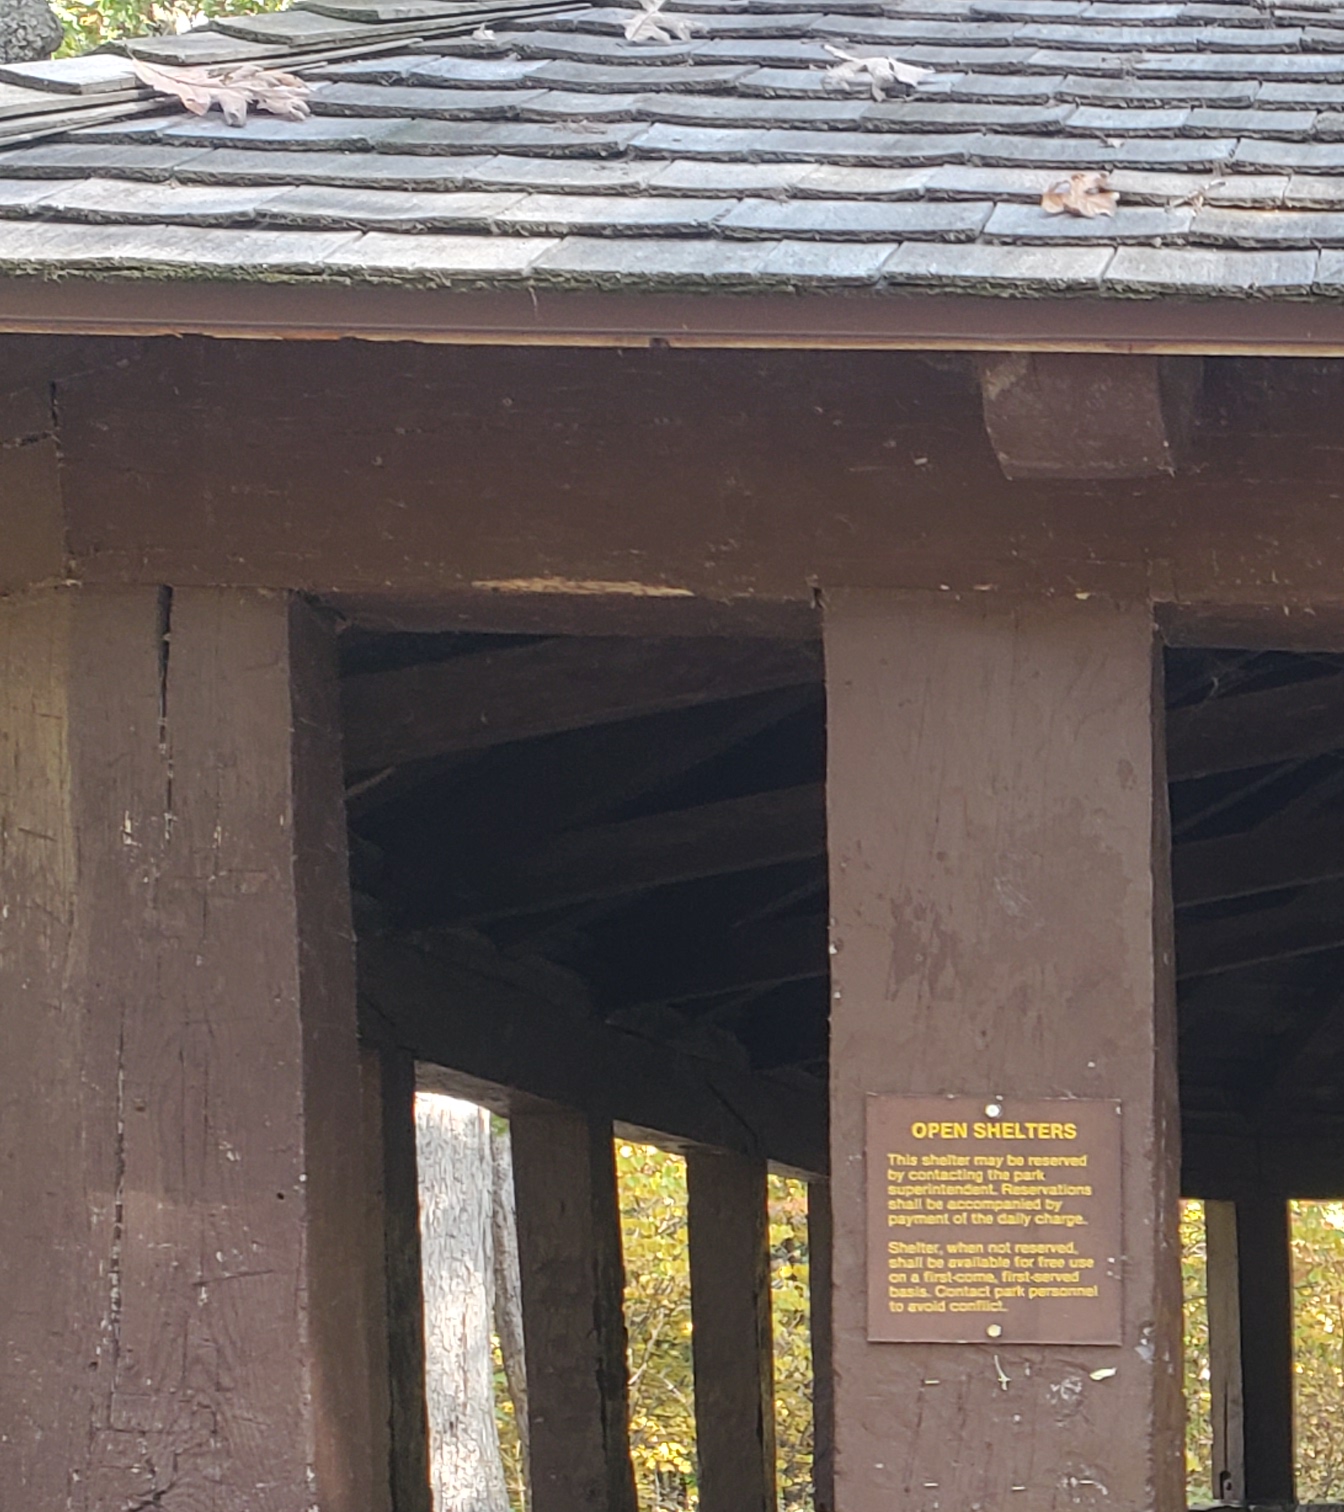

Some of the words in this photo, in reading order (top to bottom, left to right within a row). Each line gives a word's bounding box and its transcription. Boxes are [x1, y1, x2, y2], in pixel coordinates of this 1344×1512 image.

[911, 1122, 968, 1138] OPEN
[973, 1122, 1077, 1139] SHELTERS
[887, 1153, 918, 1166] This
[921, 1154, 970, 1166] shelter
[974, 1156, 1004, 1168] may
[1007, 1154, 1024, 1166] be
[1028, 1154, 1088, 1166] reserved
[887, 1169, 905, 1183] by
[908, 1169, 983, 1183] contacting
[988, 1169, 1010, 1180] the
[1013, 1169, 1046, 1182] park
[887, 1183, 998, 1196] superintendent.
[1001, 1184, 1092, 1196] Reservations
[887, 1198, 922, 1210] shall
[926, 1198, 943, 1210] be
[947, 1199, 1041, 1211] accompanied
[1045, 1199, 1062, 1212] by
[887, 1213, 950, 1226] payment
[953, 1213, 967, 1224] of
[971, 1213, 993, 1224] the
[997, 1213, 1032, 1226] daily
[946, 1242, 983, 1253] when
[988, 1242, 1011, 1253] not
[888, 1257, 923, 1268] shall
[927, 1257, 944, 1268] be
[948, 1256, 1010, 1268] available
[1014, 1256, 1035, 1268] for
[1037, 1256, 1065, 1268] free
[1069, 1258, 1095, 1268] use
[888, 1273, 907, 1282] on
[911, 1273, 920, 1282] a
[935, 1286, 991, 1297] Contact
[994, 1286, 1025, 1299] park
[1028, 1286, 1099, 1299] personnel
[889, 1301, 904, 1312] to
[908, 1301, 946, 1312] avoid
